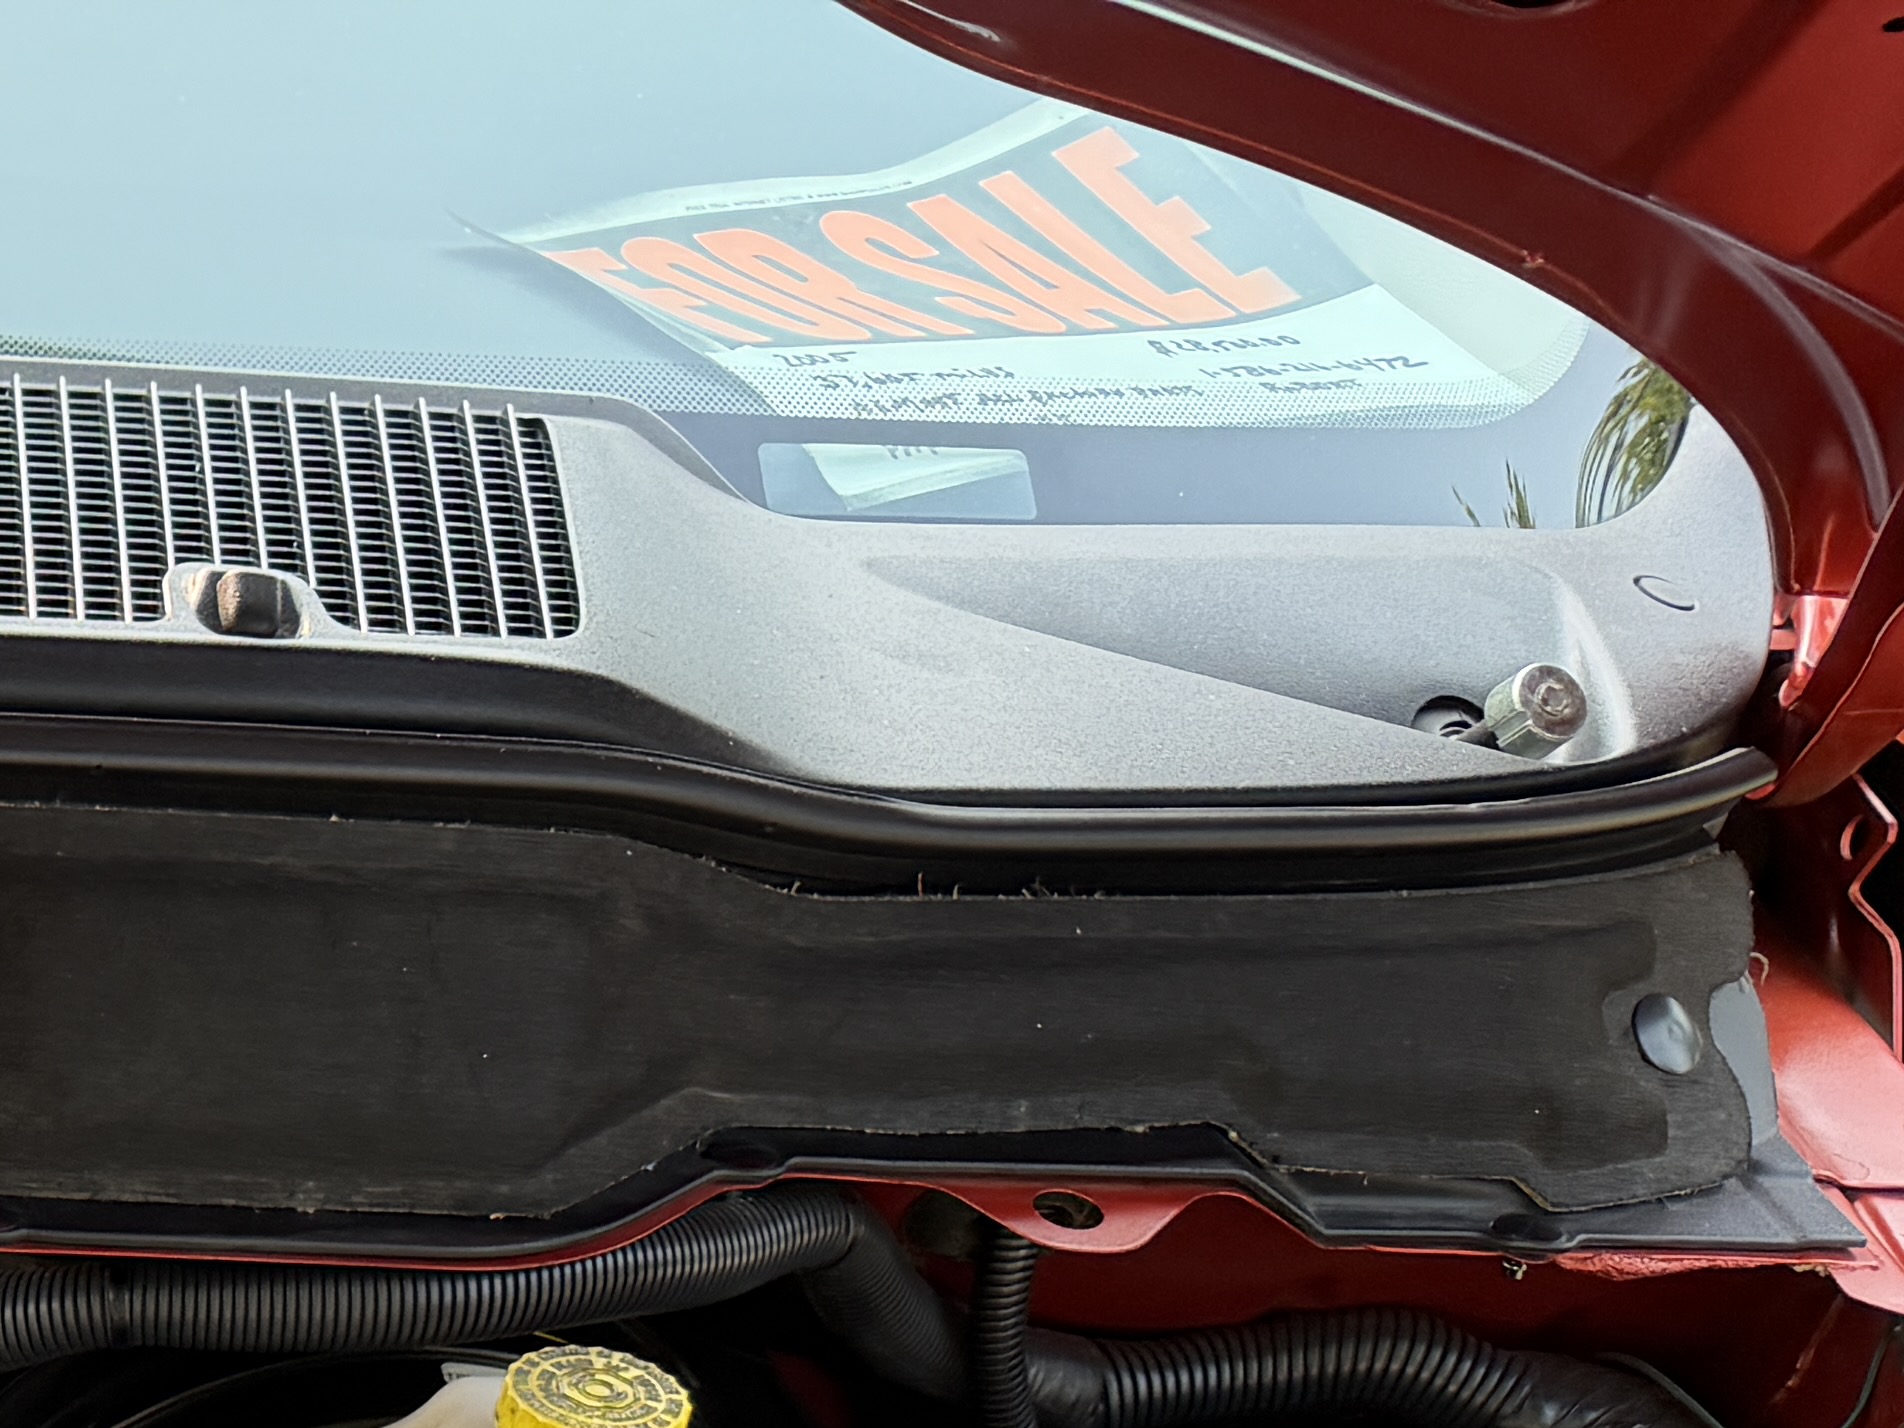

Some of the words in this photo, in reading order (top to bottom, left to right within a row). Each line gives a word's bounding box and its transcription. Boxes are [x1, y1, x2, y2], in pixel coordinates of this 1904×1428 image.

[543, 227, 974, 343] FOR
[818, 126, 1301, 334] SALE
[773, 350, 856, 367] 2005
